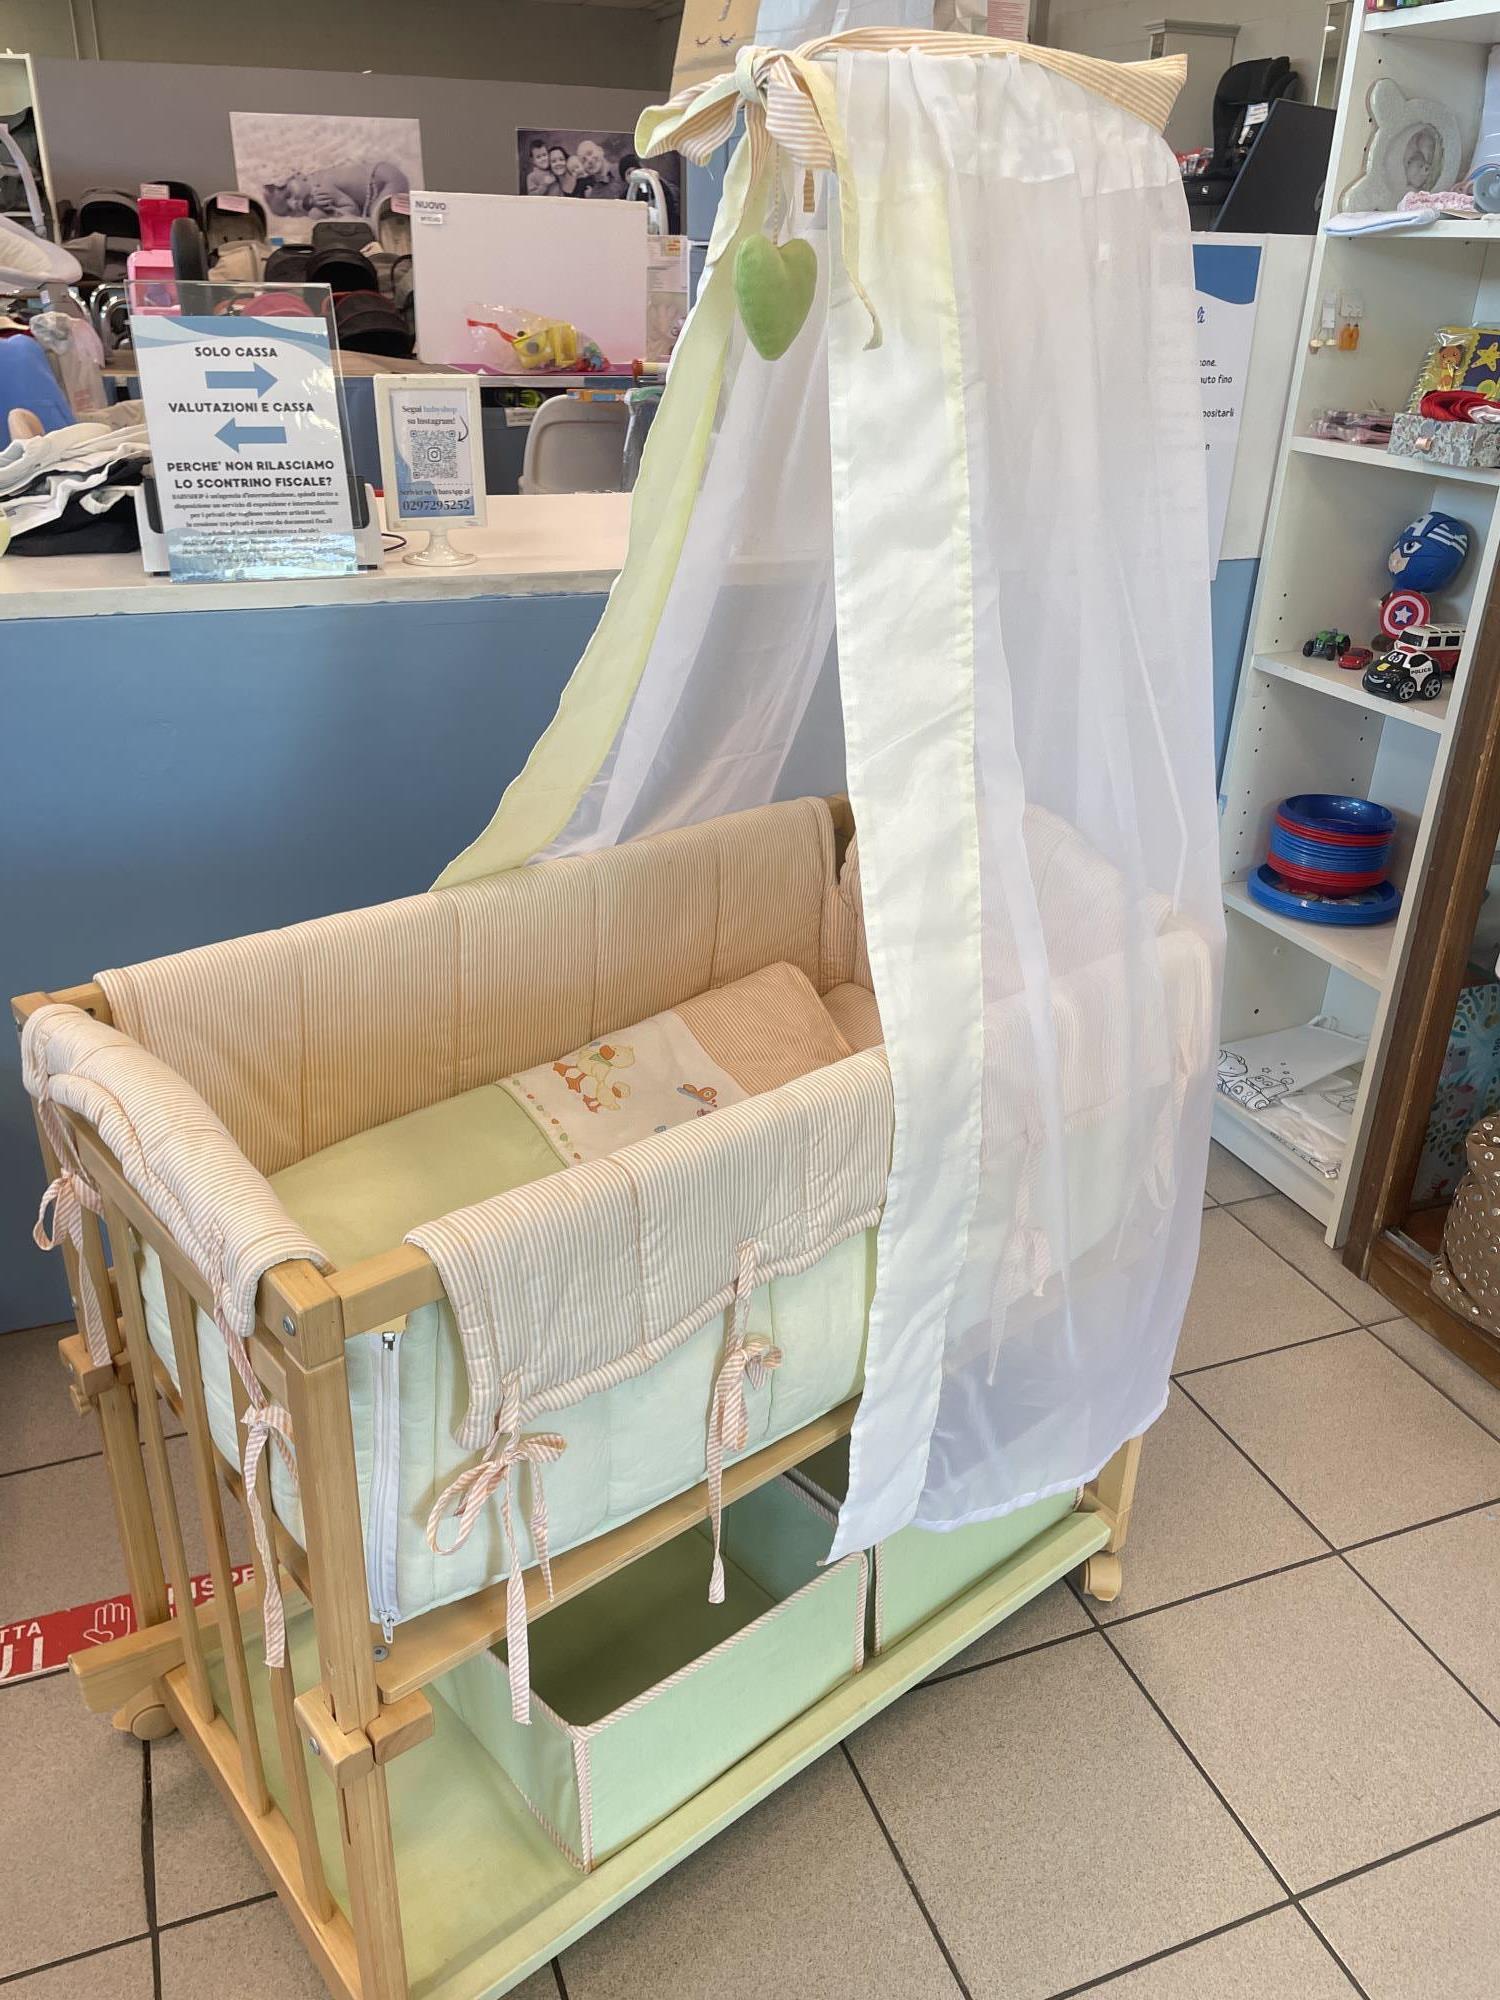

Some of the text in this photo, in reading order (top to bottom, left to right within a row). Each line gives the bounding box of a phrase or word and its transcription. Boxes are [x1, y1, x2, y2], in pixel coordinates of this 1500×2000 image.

[415, 200, 446, 210] NUOVO
[194, 346, 278, 357] SOLO CASSA
[1218, 374, 1233, 385] fino
[168, 402, 315, 413] VALUTAZIONI E CASSA
[167, 460, 334, 472] PERCHE' NON RILASCIAMO
[174, 476, 332, 489] LO SCONTRINO FISCALE?
[402, 500, 470, 511] 0297295252
